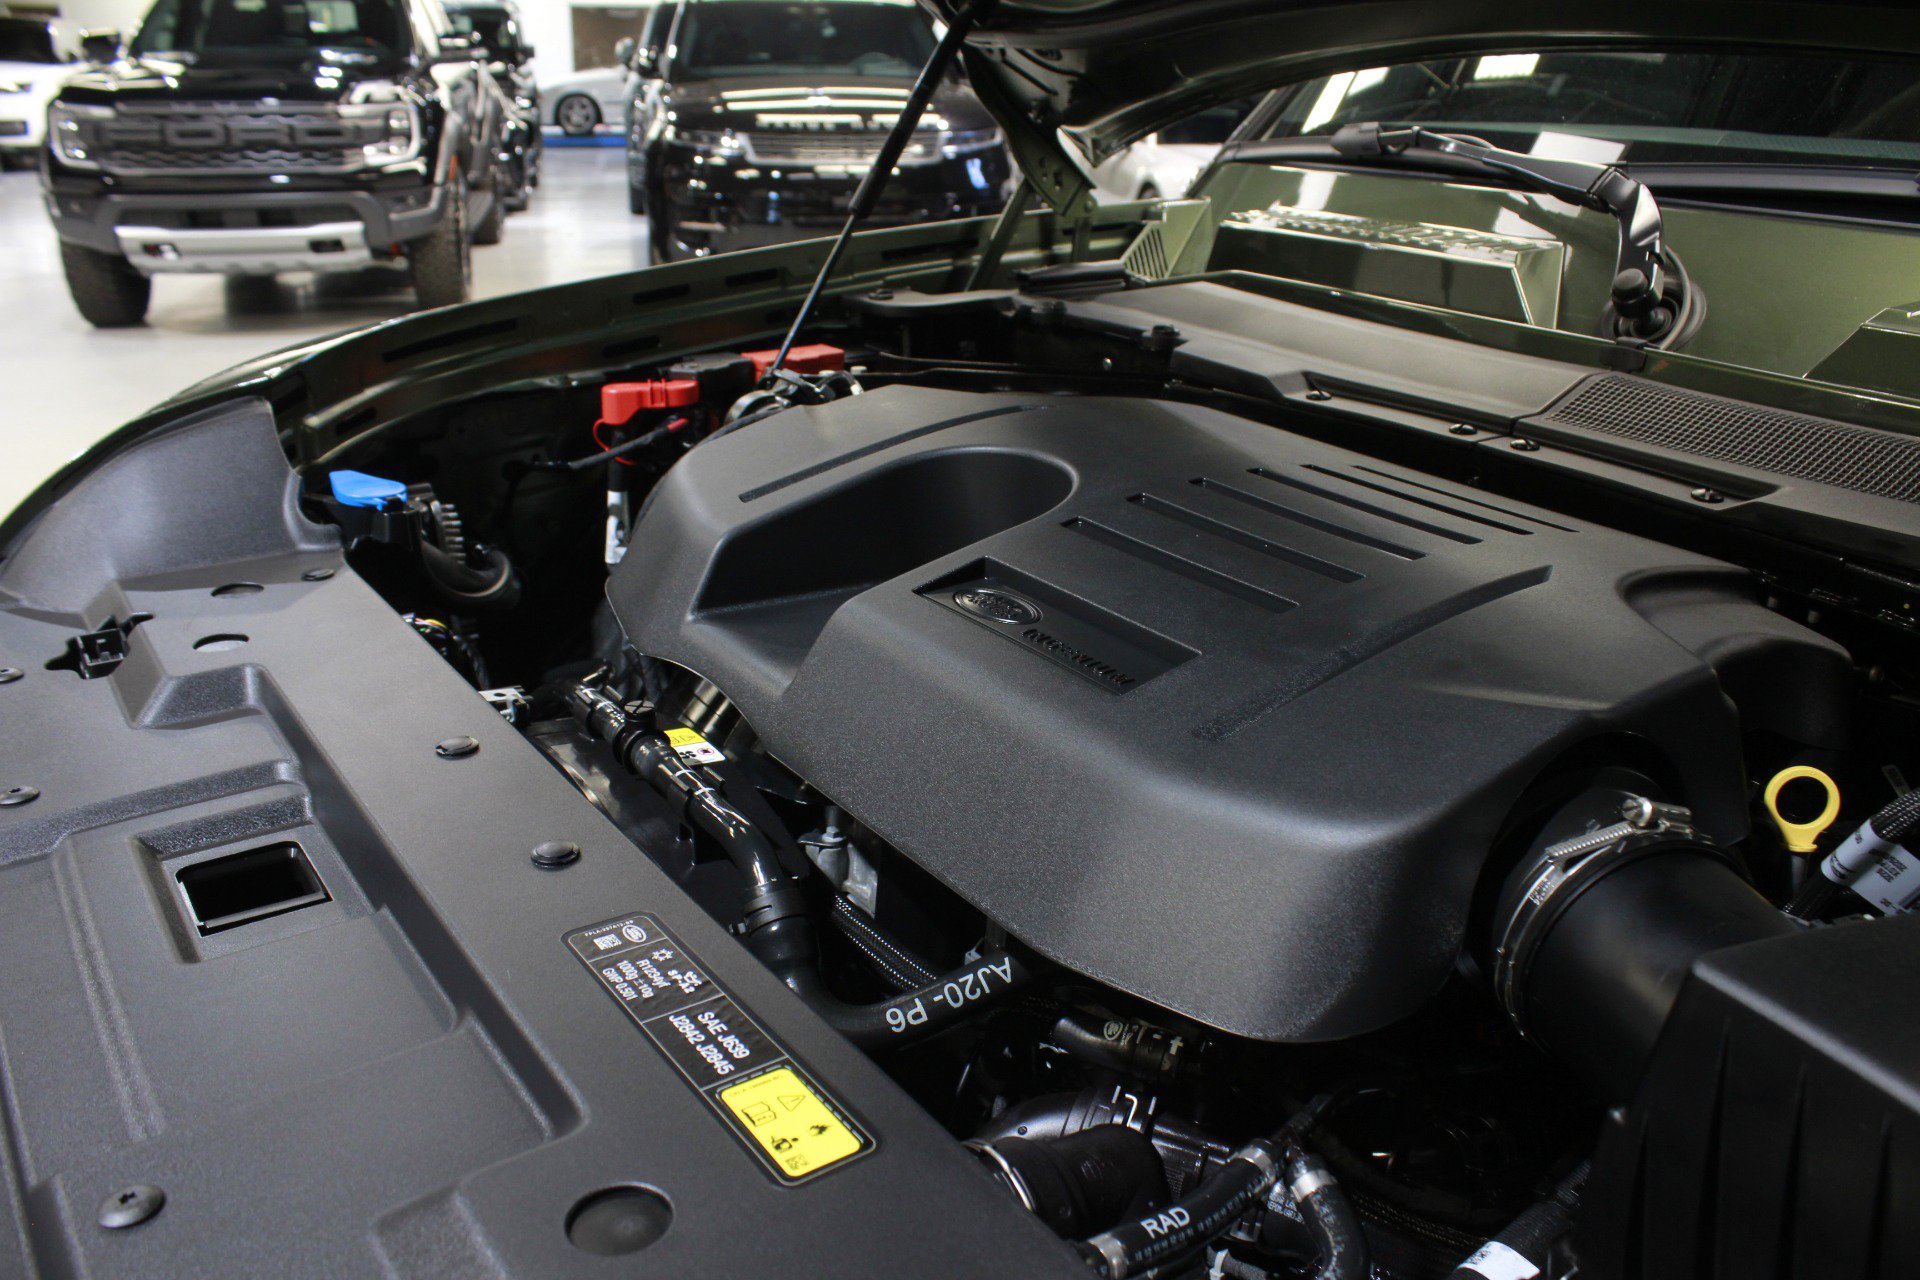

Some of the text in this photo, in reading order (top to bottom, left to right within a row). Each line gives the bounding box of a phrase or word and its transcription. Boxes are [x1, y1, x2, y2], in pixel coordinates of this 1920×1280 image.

[98, 119, 355, 147] FORD
[602, 968, 622, 985] GWP
[636, 959, 672, 988] R1234yf
[885, 997, 928, 1034] P6
[668, 1013, 735, 1074] J2842 J2845
[697, 1011, 751, 1059] SAE J639
[1140, 1206, 1191, 1240] RAD
